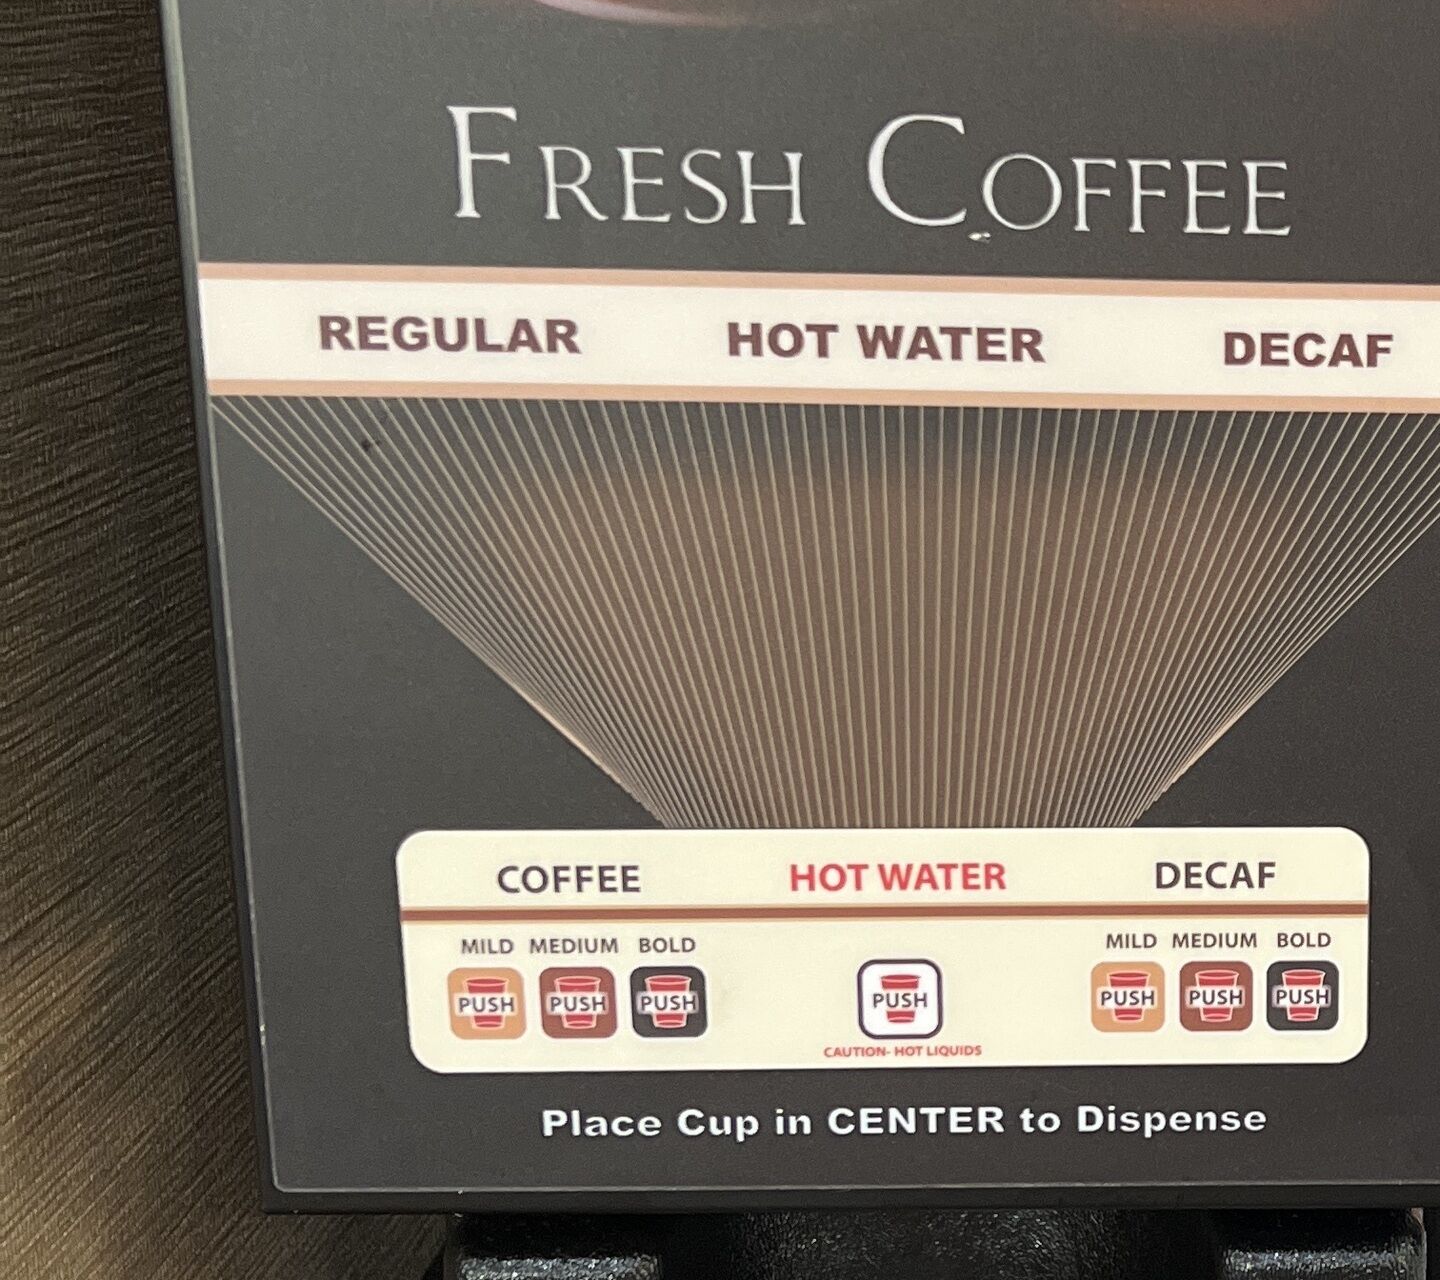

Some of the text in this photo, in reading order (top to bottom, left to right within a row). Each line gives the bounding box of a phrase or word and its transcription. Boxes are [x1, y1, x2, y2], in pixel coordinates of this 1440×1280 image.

[444, 104, 1292, 238] FRESH COFFEE
[319, 315, 581, 357] REGULAR
[727, 321, 1046, 365] HOT WATER
[1223, 330, 1394, 370] DECAF
[497, 865, 642, 894] COFFEE
[790, 863, 1007, 892] HOT WATER
[1155, 861, 1276, 889] DECAF
[461, 937, 697, 954] MILD MEDIUM BOLD
[1106, 932, 1331, 949] MILD MEDIUM BOLD
[458, 996, 516, 1013] PUSH
[549, 996, 607, 1012] PUSH
[640, 995, 697, 1011] PUSH
[873, 992, 928, 1009] PUSH
[1100, 990, 1156, 1007] PUSH
[1189, 990, 1244, 1006] PUSH
[1276, 989, 1330, 1005] PUSH
[894, 1045, 924, 1057] HOT
[926, 1044, 983, 1057] LIQUIDS
[541, 1104, 1268, 1143] Place Cup in CENTER to Dispense
